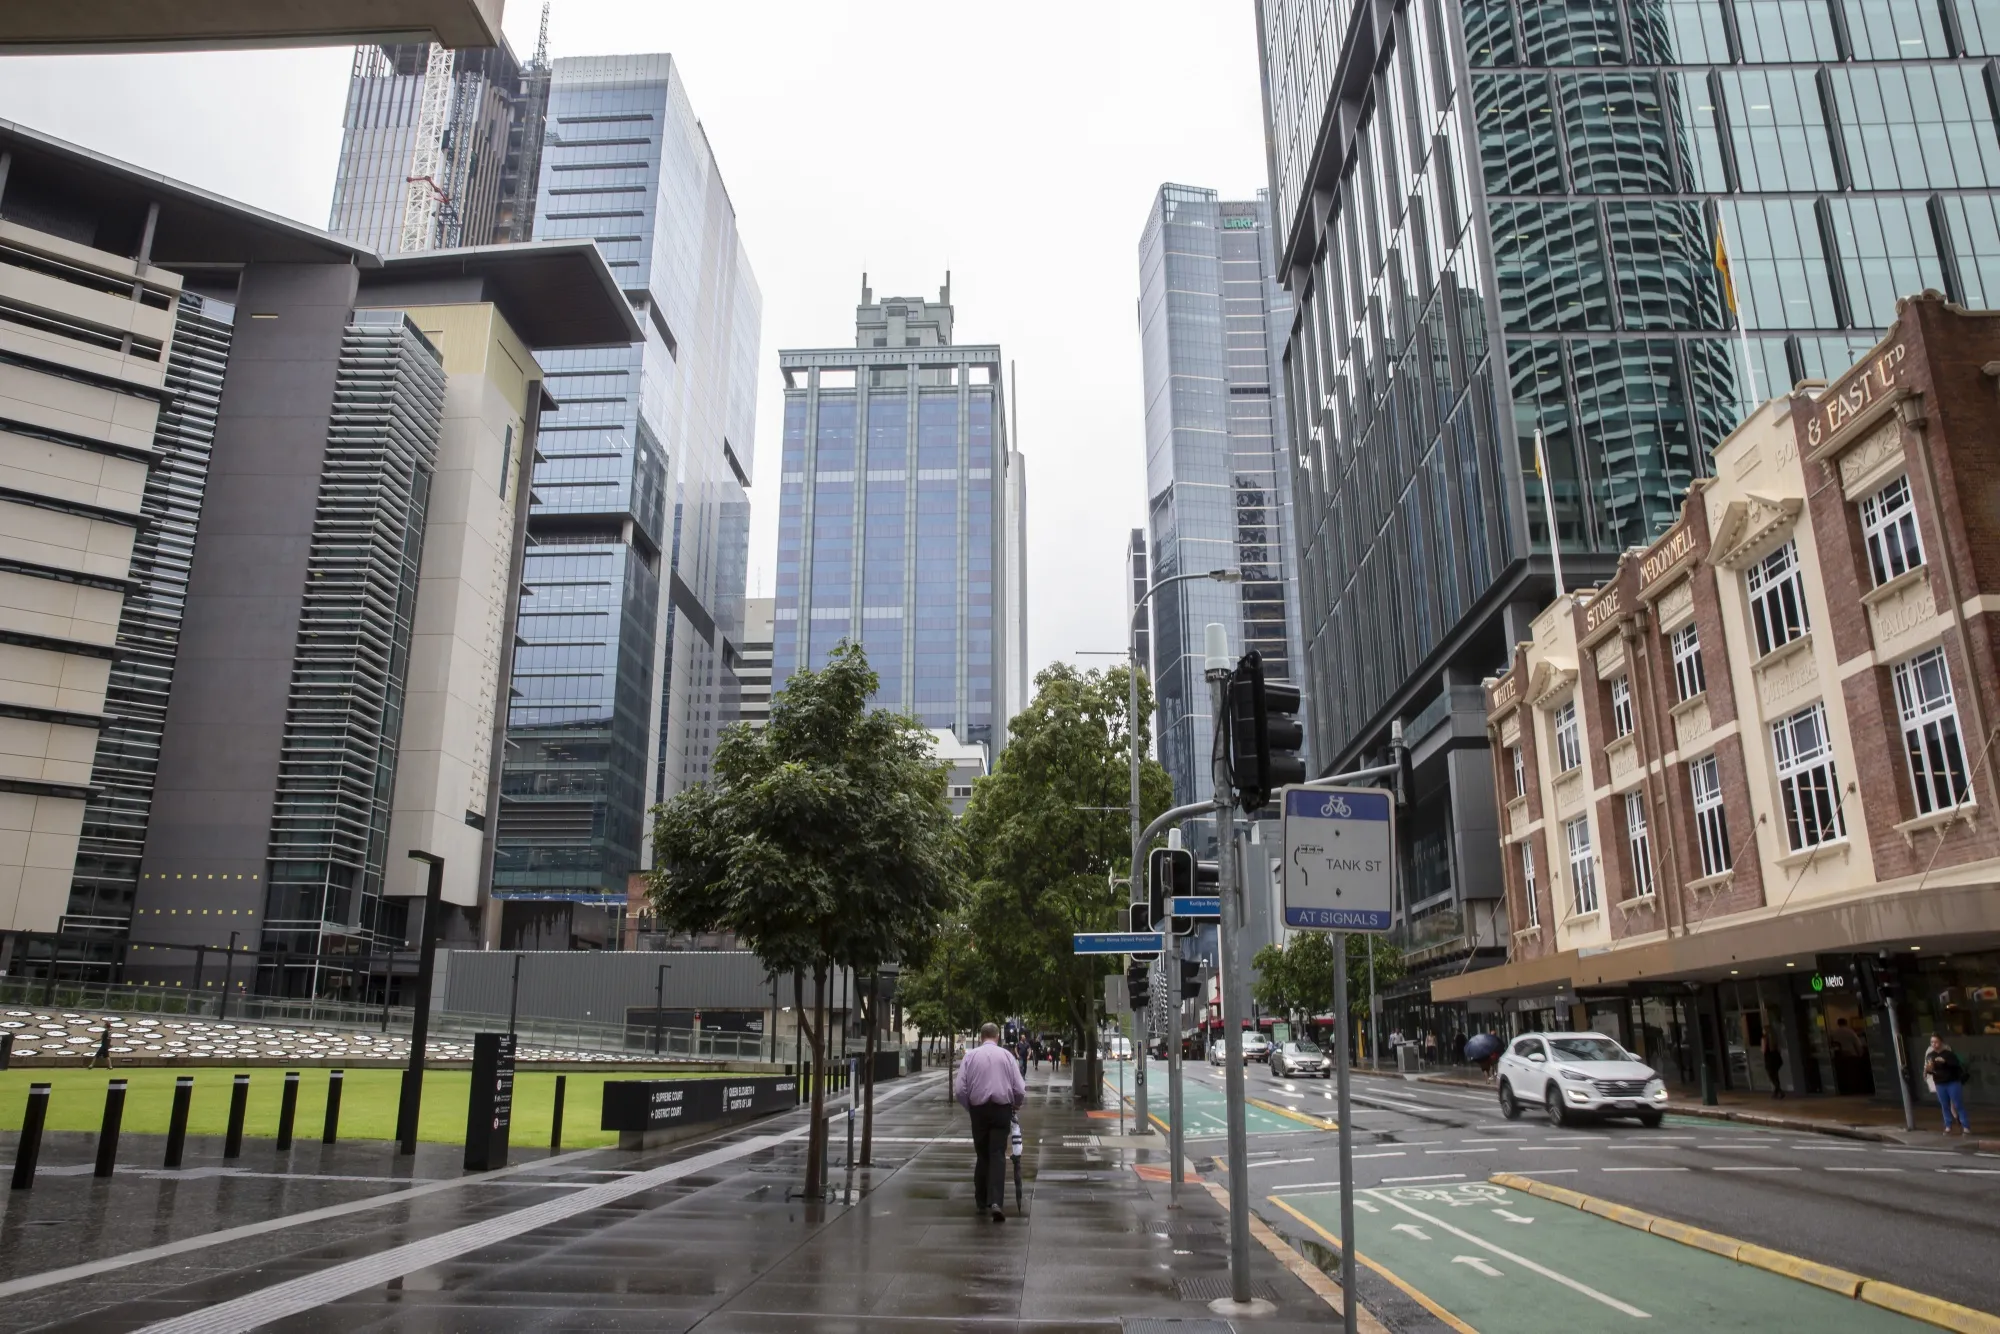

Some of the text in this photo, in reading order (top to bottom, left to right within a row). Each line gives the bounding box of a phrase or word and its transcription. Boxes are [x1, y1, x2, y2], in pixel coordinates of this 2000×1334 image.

[1808, 417, 1821, 447] &
[1826, 370, 1872, 433] EAST
[1587, 587, 1620, 632] STORE
[1877, 597, 1937, 643] TAILORS
[1493, 677, 1516, 708] WHITE
[1325, 858, 1382, 872] TANK ST
[1299, 911, 1378, 925] AT SIGNALS
[1825, 975, 1844, 987] Metro
[656, 1090, 683, 1102] SUPREME COURT
[729, 1087, 738, 1097] QUEEN
[739, 1086, 752, 1096] ELIZABETH
[731, 1099, 741, 1110] COURTS
[655, 1106, 682, 1119] DISTRICT COURT
